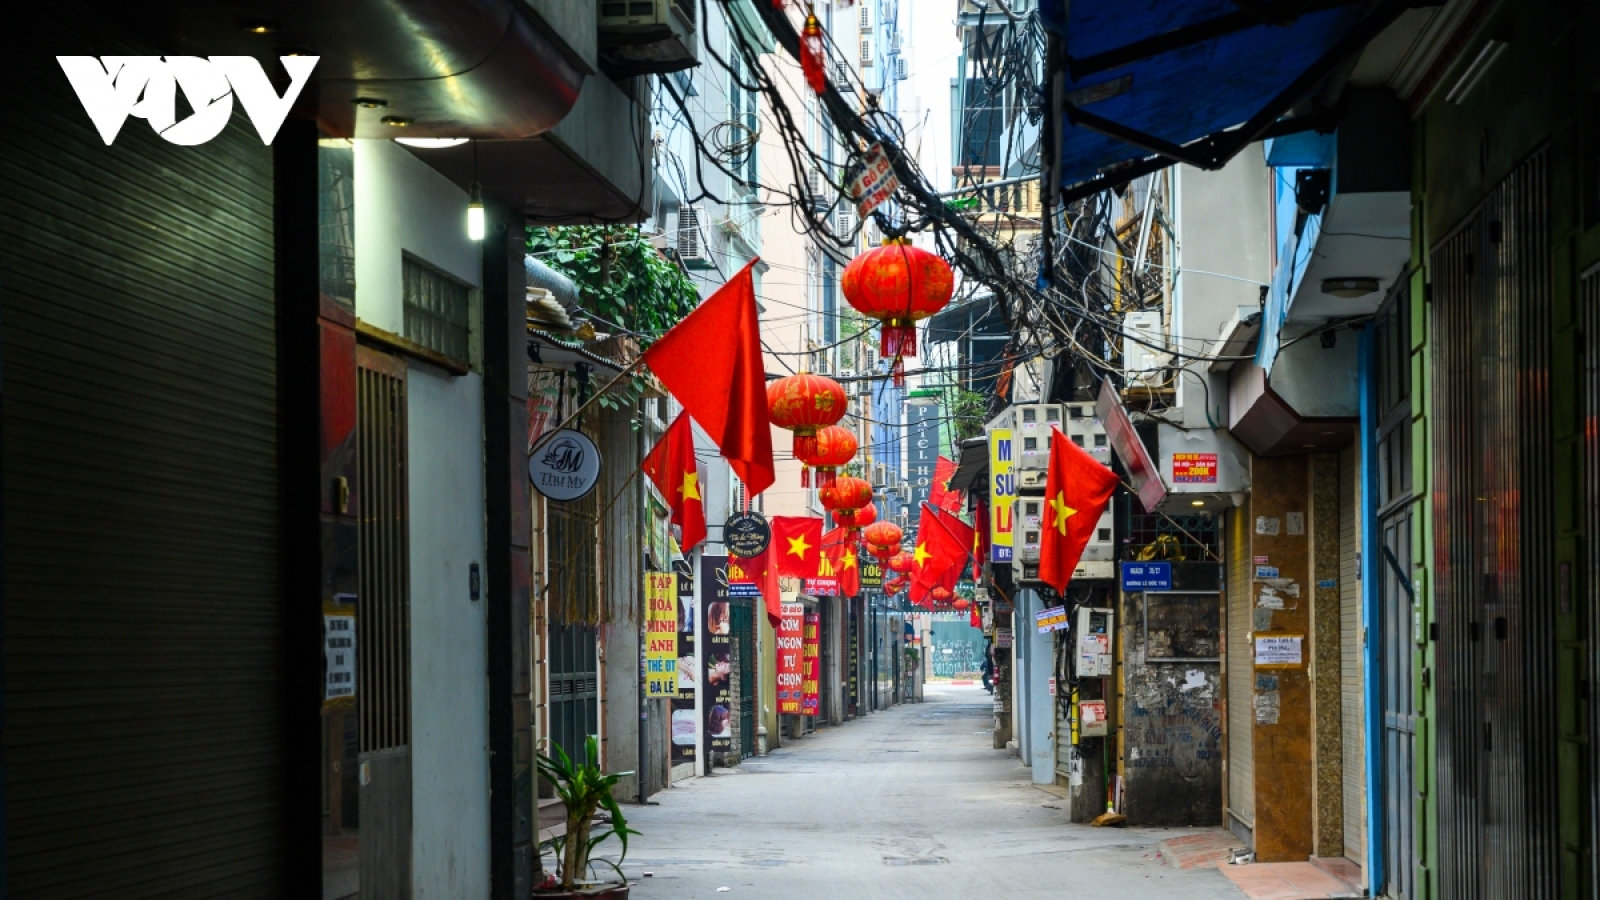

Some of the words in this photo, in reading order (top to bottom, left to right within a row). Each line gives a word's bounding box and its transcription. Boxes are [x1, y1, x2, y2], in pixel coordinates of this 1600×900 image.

[1188, 467, 1209, 476] 200K
[650, 576, 672, 592] TẠP
[647, 620, 676, 633] MINH
[649, 640, 674, 652] ANH
[777, 636, 802, 649] NGON
[803, 643, 818, 658] GON
[784, 653, 797, 671] TỰ
[778, 673, 802, 689] CHỌN
[782, 702, 798, 711] WIFI
